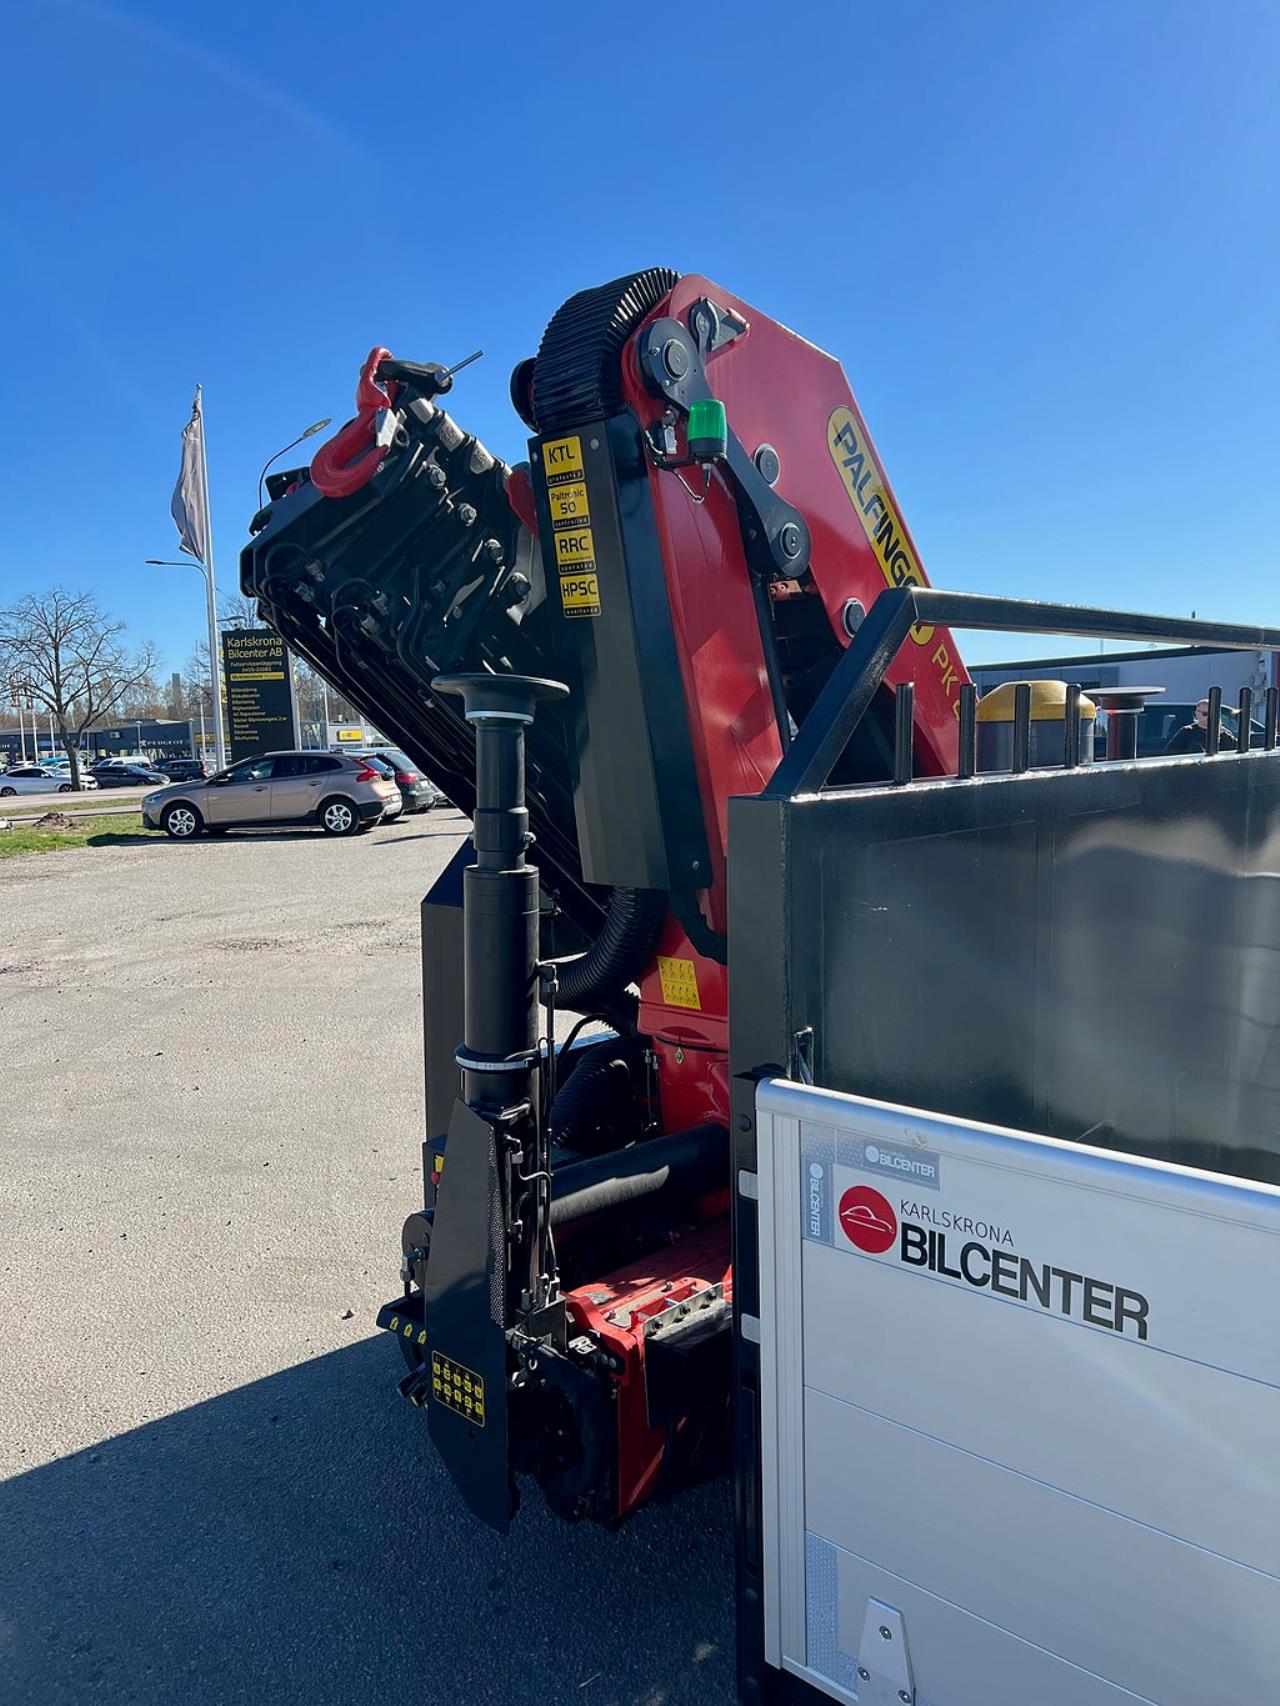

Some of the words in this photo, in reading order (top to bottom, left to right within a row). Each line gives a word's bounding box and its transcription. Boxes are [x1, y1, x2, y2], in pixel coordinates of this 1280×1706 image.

[549, 446, 575, 463] KTL
[560, 501, 576, 515] 50
[833, 421, 919, 588] PALFING
[559, 535, 589, 554] RRC
[562, 580, 597, 598] HPSC
[227, 637, 282, 648] Karlskrona
[228, 649, 268, 659] Bilcenter
[269, 647, 283, 657] AB
[932, 643, 960, 697] PK
[879, 1153, 935, 1178] BILCENTER
[810, 1178, 820, 1237] BILCENTER
[900, 1200, 1015, 1247] KARLSKRONA
[900, 1221, 1149, 1341] BILCENTER
